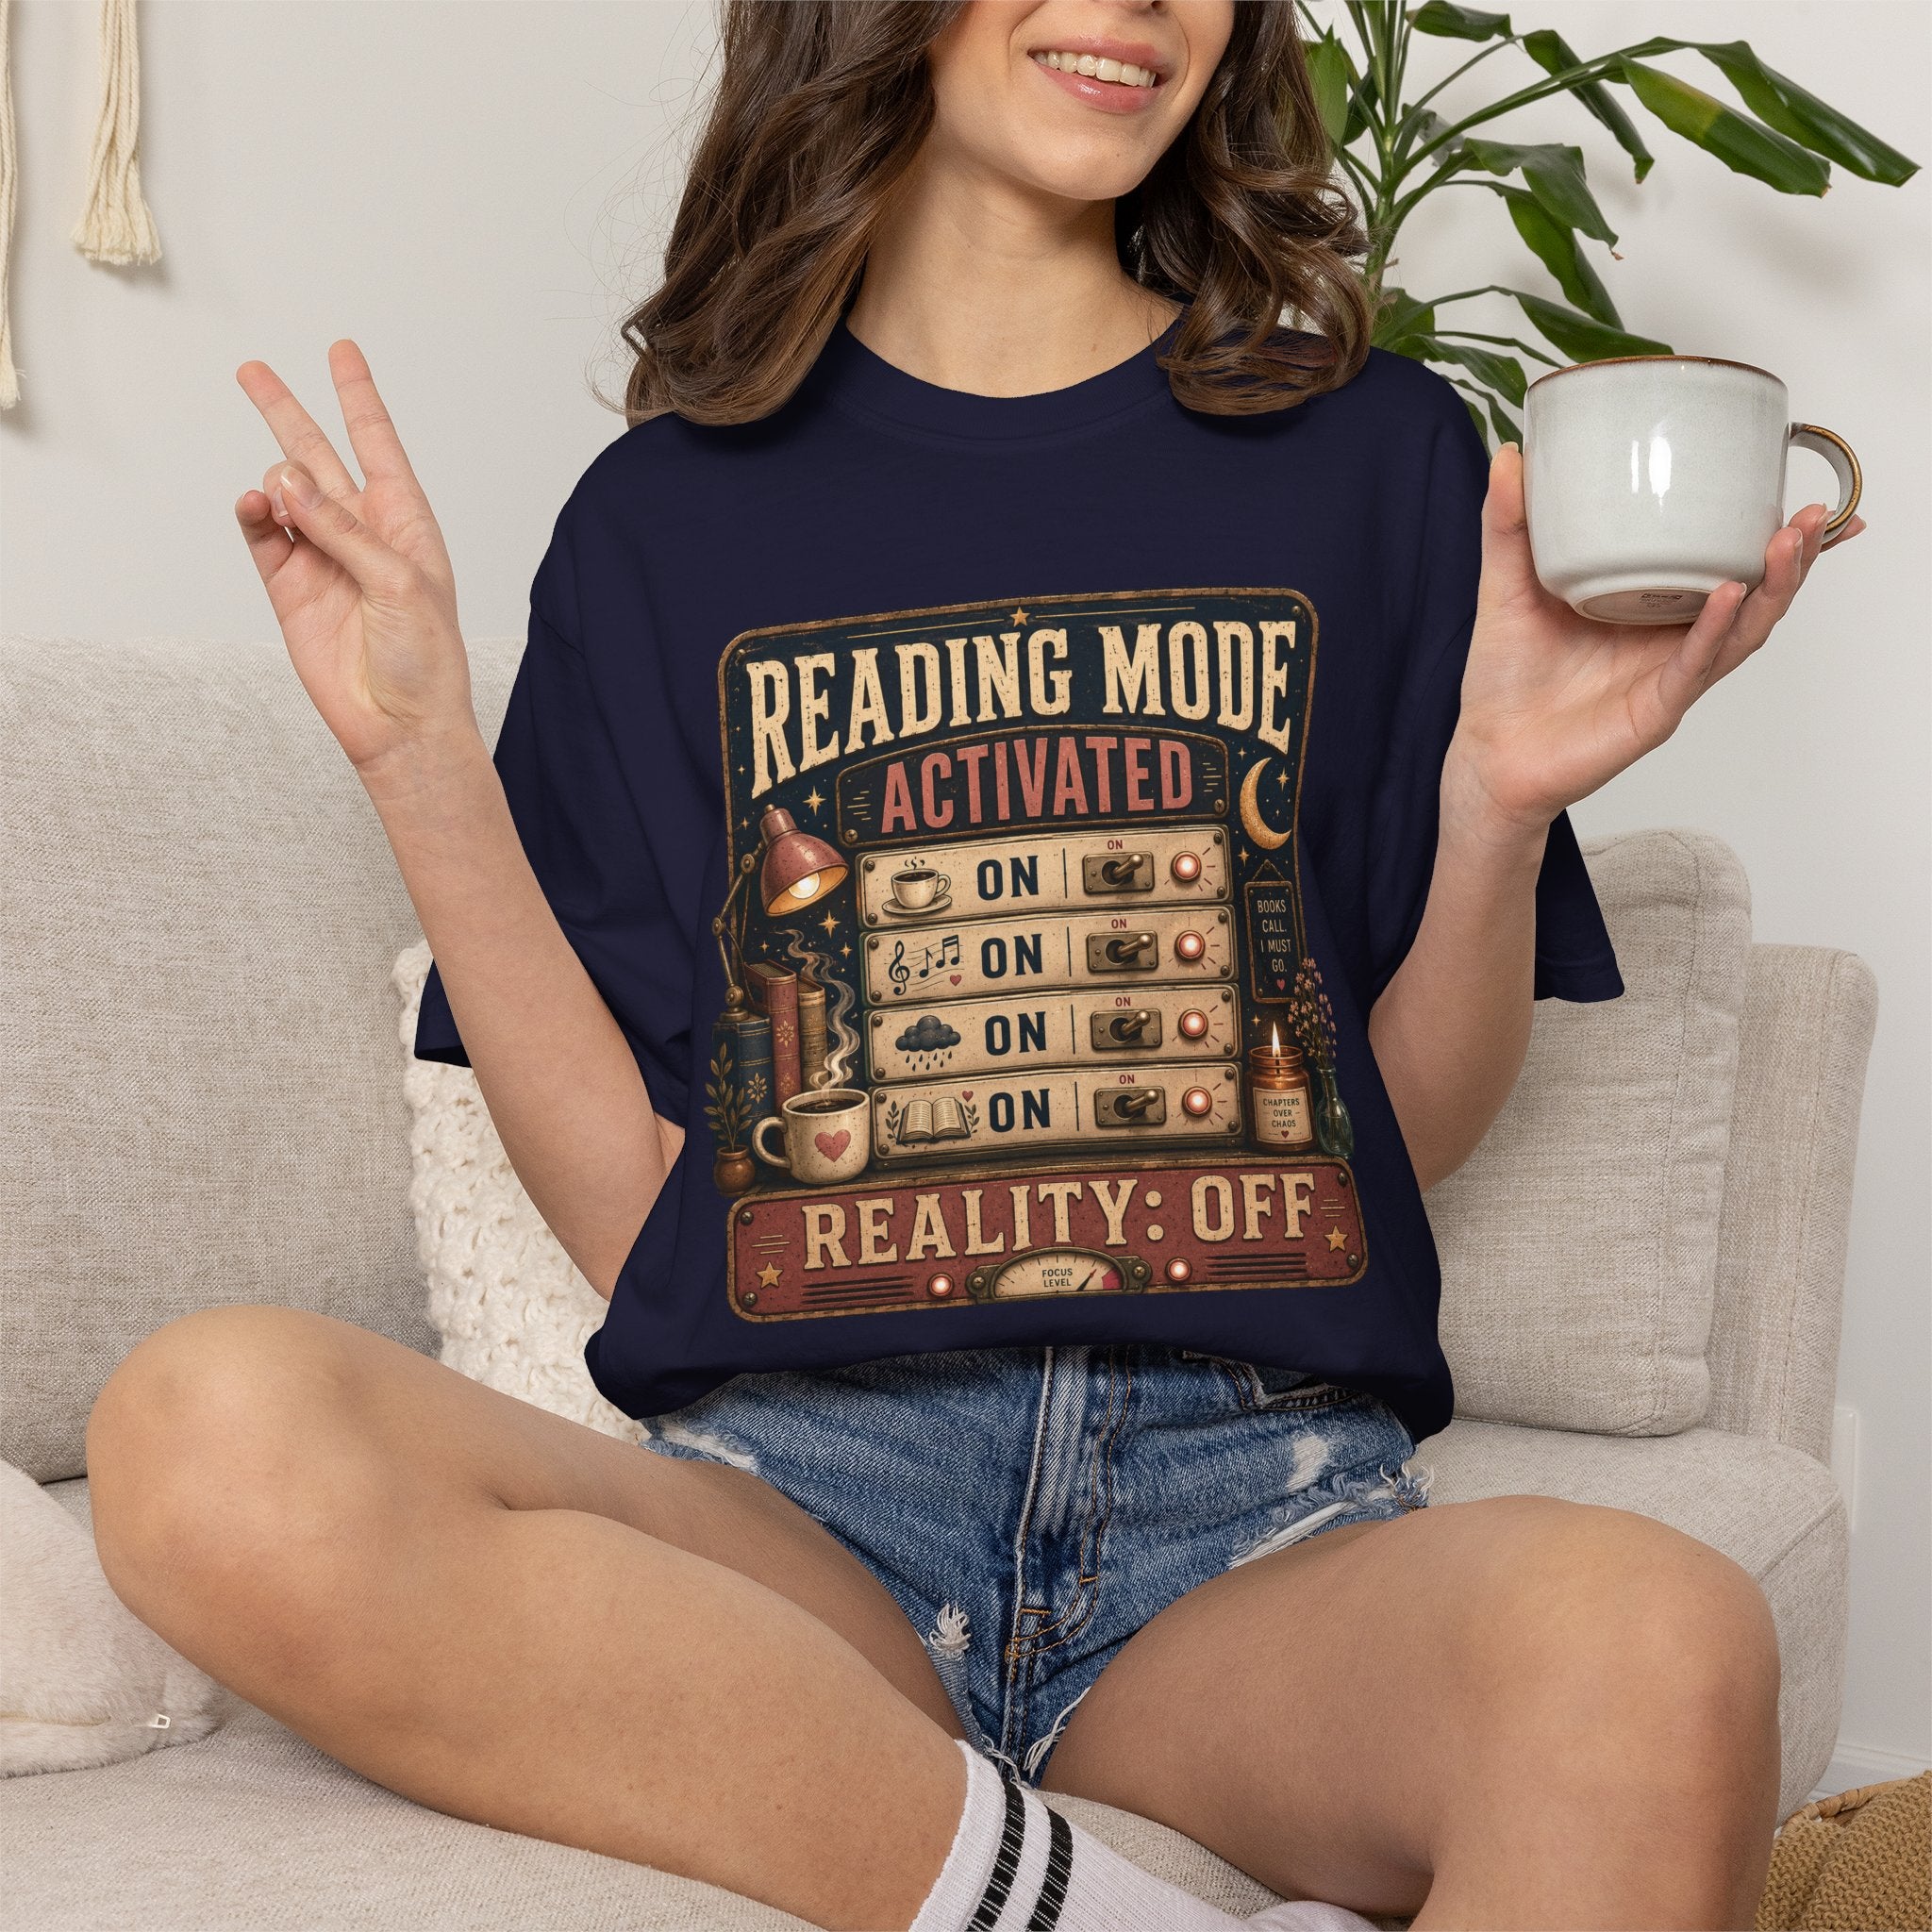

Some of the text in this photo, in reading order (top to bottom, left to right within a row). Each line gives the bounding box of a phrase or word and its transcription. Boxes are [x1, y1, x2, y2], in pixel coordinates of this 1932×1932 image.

[746, 621, 1296, 799] READING MODE
[881, 736, 1192, 833] ACTIVATED
[1107, 839, 1124, 851] ON
[977, 855, 1039, 901] ON
[1257, 899, 1287, 913] BOOKS
[1110, 919, 1127, 930] ON
[1261, 919, 1287, 933] CALL.
[1260, 939, 1291, 953] I MUST
[981, 933, 1043, 979] ON
[1272, 958, 1288, 973] GO.
[1115, 996, 1131, 1008] ON
[985, 1011, 1047, 1056] ON
[1119, 1074, 1136, 1086] ON
[1262, 1098, 1300, 1107] CHAPTERS
[989, 1088, 1051, 1133] ON
[1271, 1120, 1296, 1128] CHAOS
[801, 1173, 1316, 1271] REALITY: OFF
[1041, 1268, 1073, 1277] FOCUS
[1043, 1278, 1072, 1288] LEVEL
